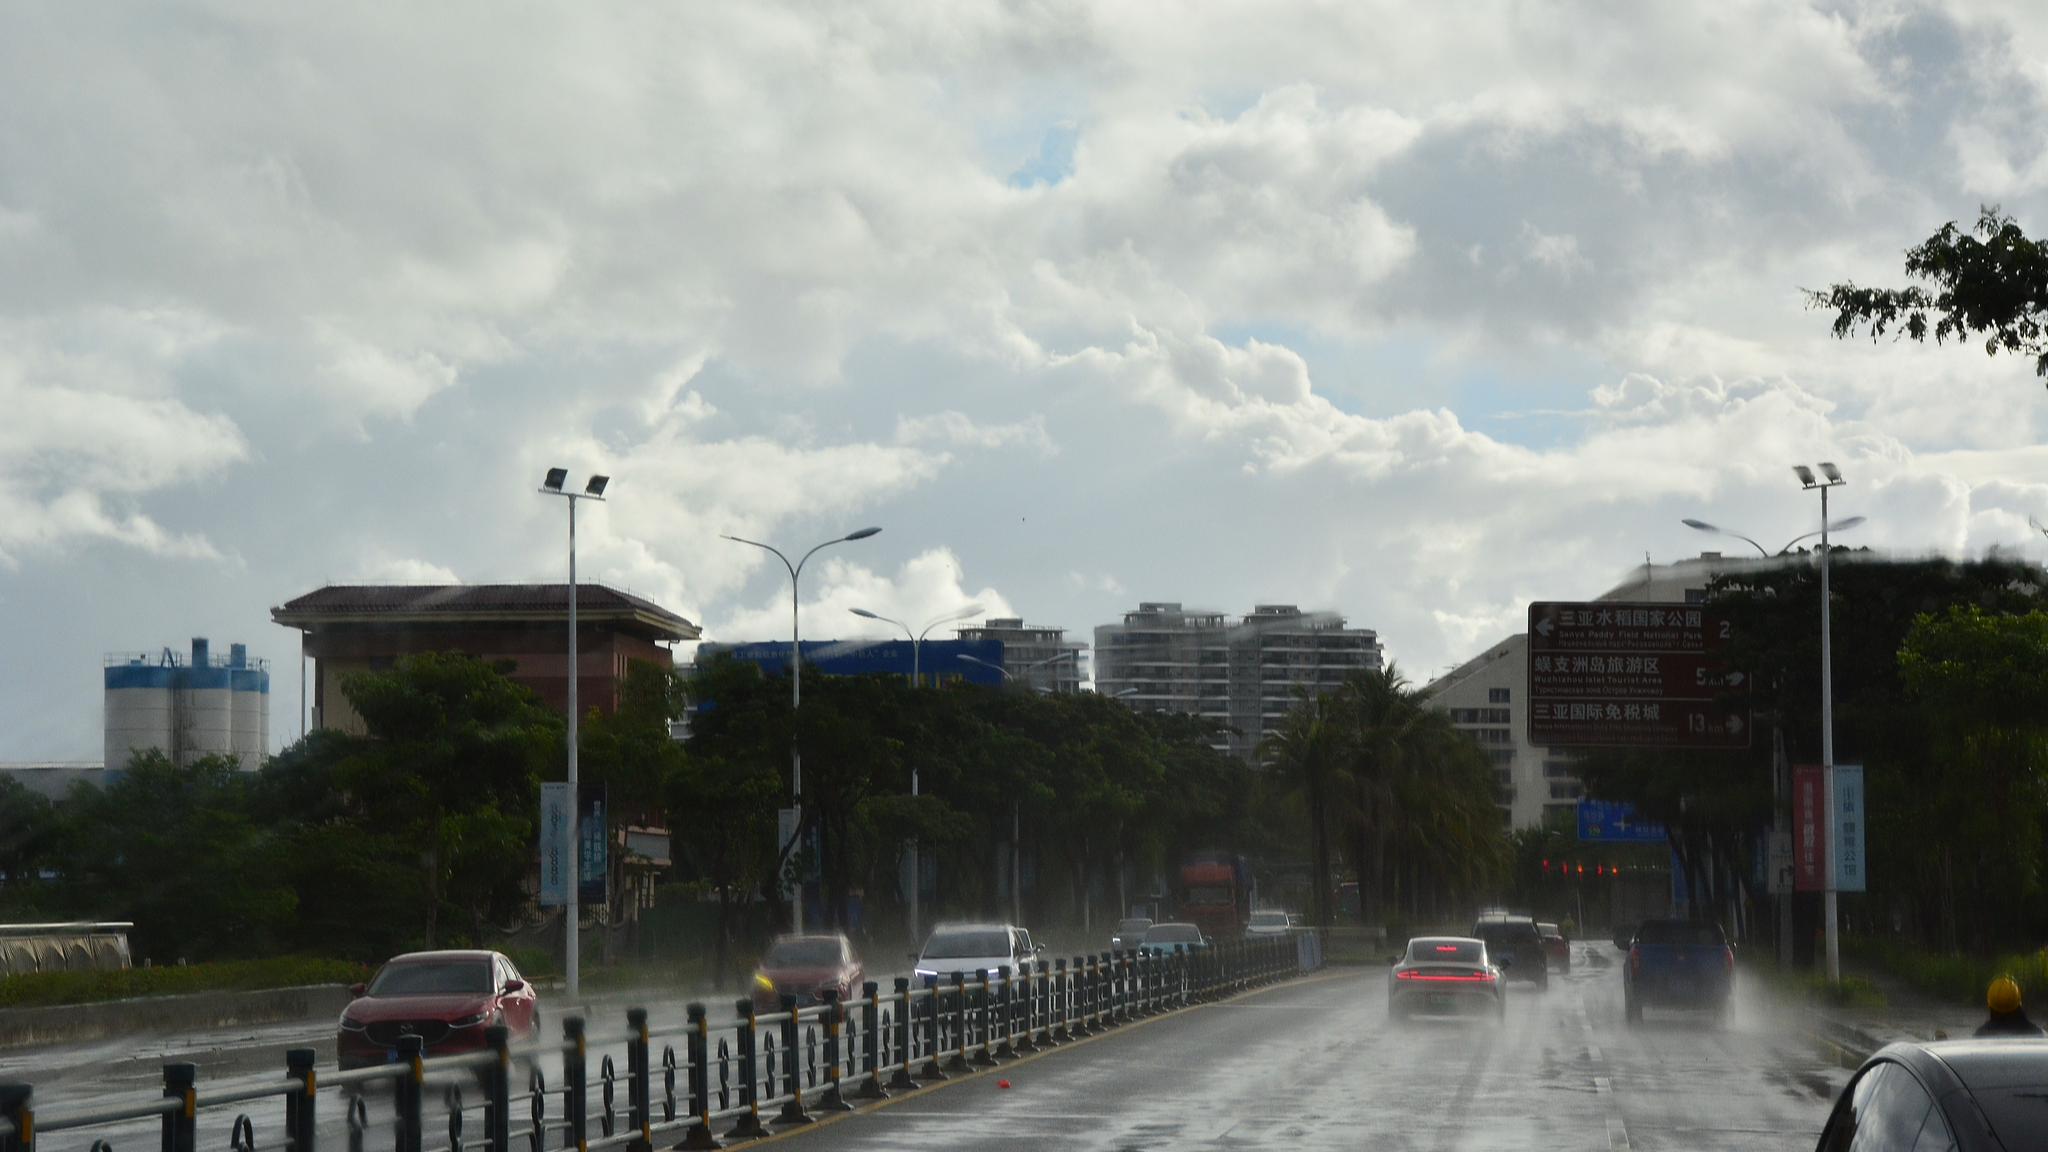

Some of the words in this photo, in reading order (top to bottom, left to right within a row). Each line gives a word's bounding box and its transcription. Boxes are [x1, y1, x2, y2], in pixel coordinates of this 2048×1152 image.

[1559, 609, 1702, 628] 三亚水稻国家公园
[1559, 630, 1585, 640] Sanya
[1588, 630, 1614, 640] Paddy
[1618, 630, 1639, 639] Field
[1643, 630, 1679, 639] National
[1683, 631, 1703, 640] Park
[1534, 655, 1660, 674] 蜈支洲岛旅游区
[1534, 676, 1584, 685] Wuzhizhou
[1585, 676, 1605, 685] Islet
[1608, 676, 1639, 685] Tourist
[1642, 676, 1663, 685] Area
[1534, 703, 1660, 721] 三亚国际免税城
[1688, 713, 1705, 732] 13
